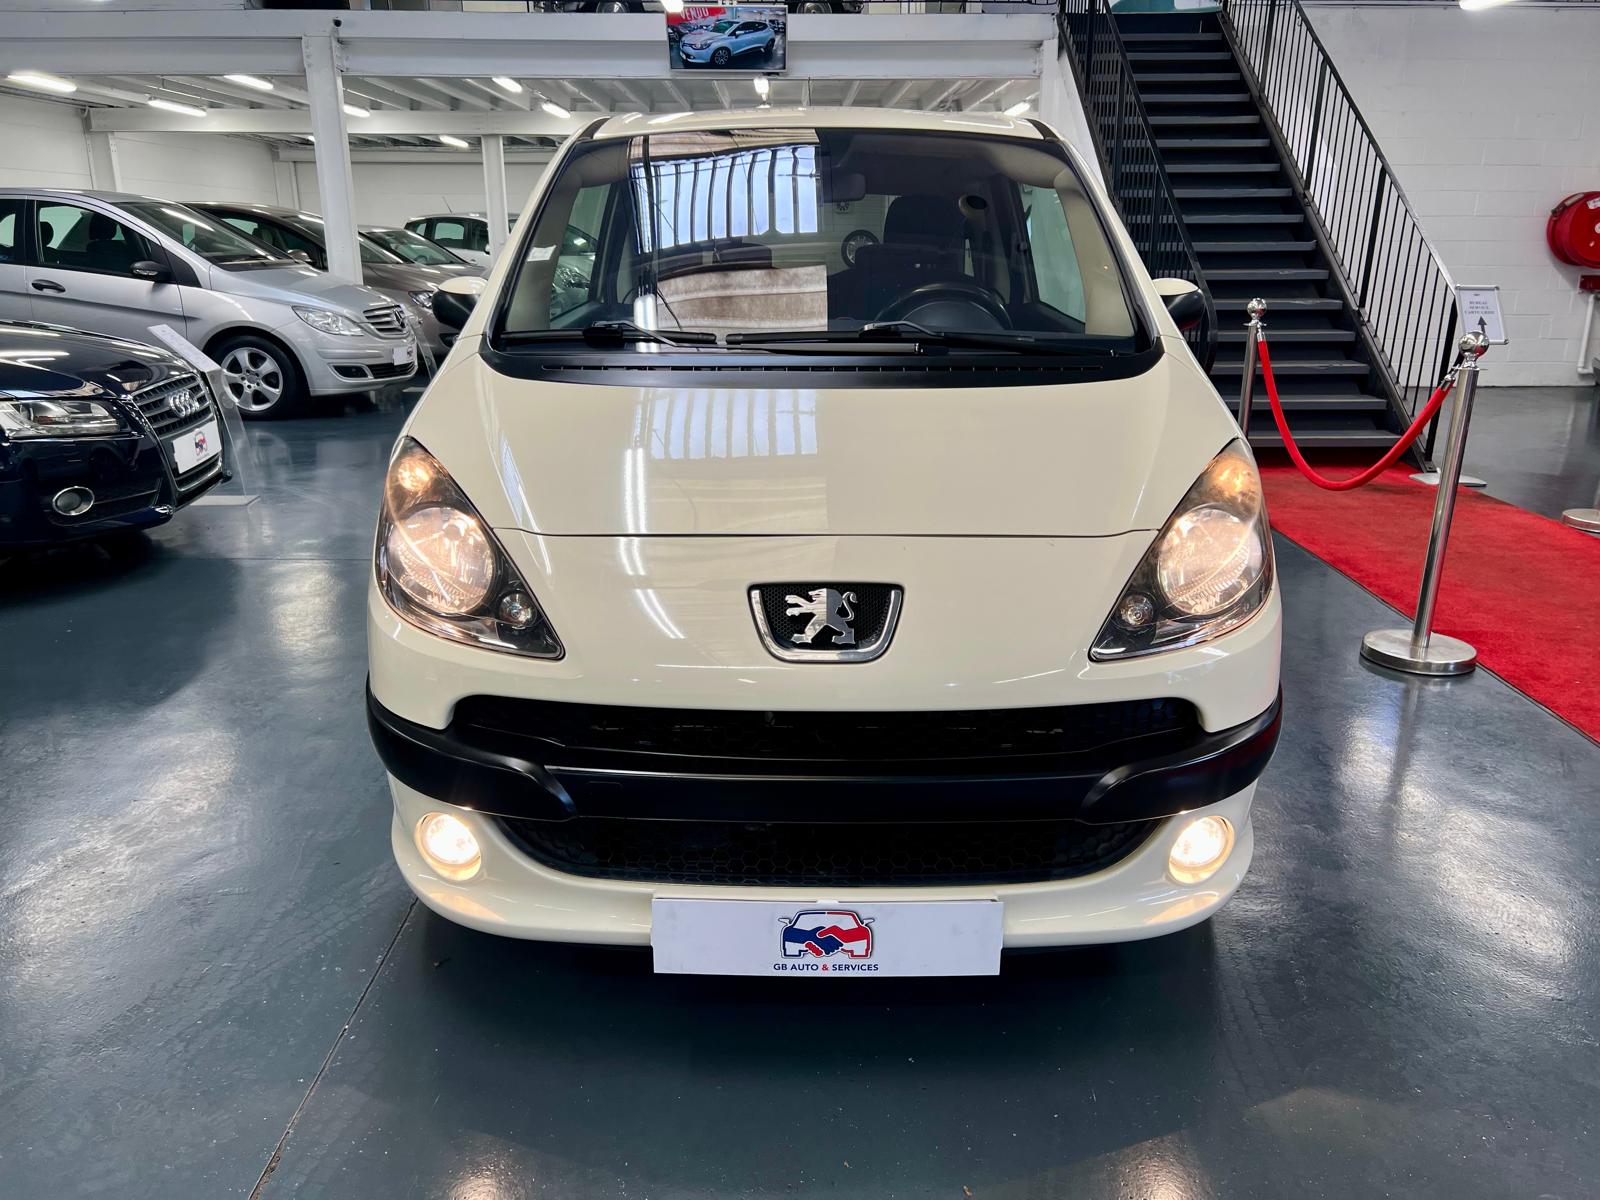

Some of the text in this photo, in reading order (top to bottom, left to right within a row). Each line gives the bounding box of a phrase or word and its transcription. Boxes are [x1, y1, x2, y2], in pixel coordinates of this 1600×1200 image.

[680, 7, 709, 20] VENDU
[773, 963, 879, 971] GB AUTO & SERVICES
